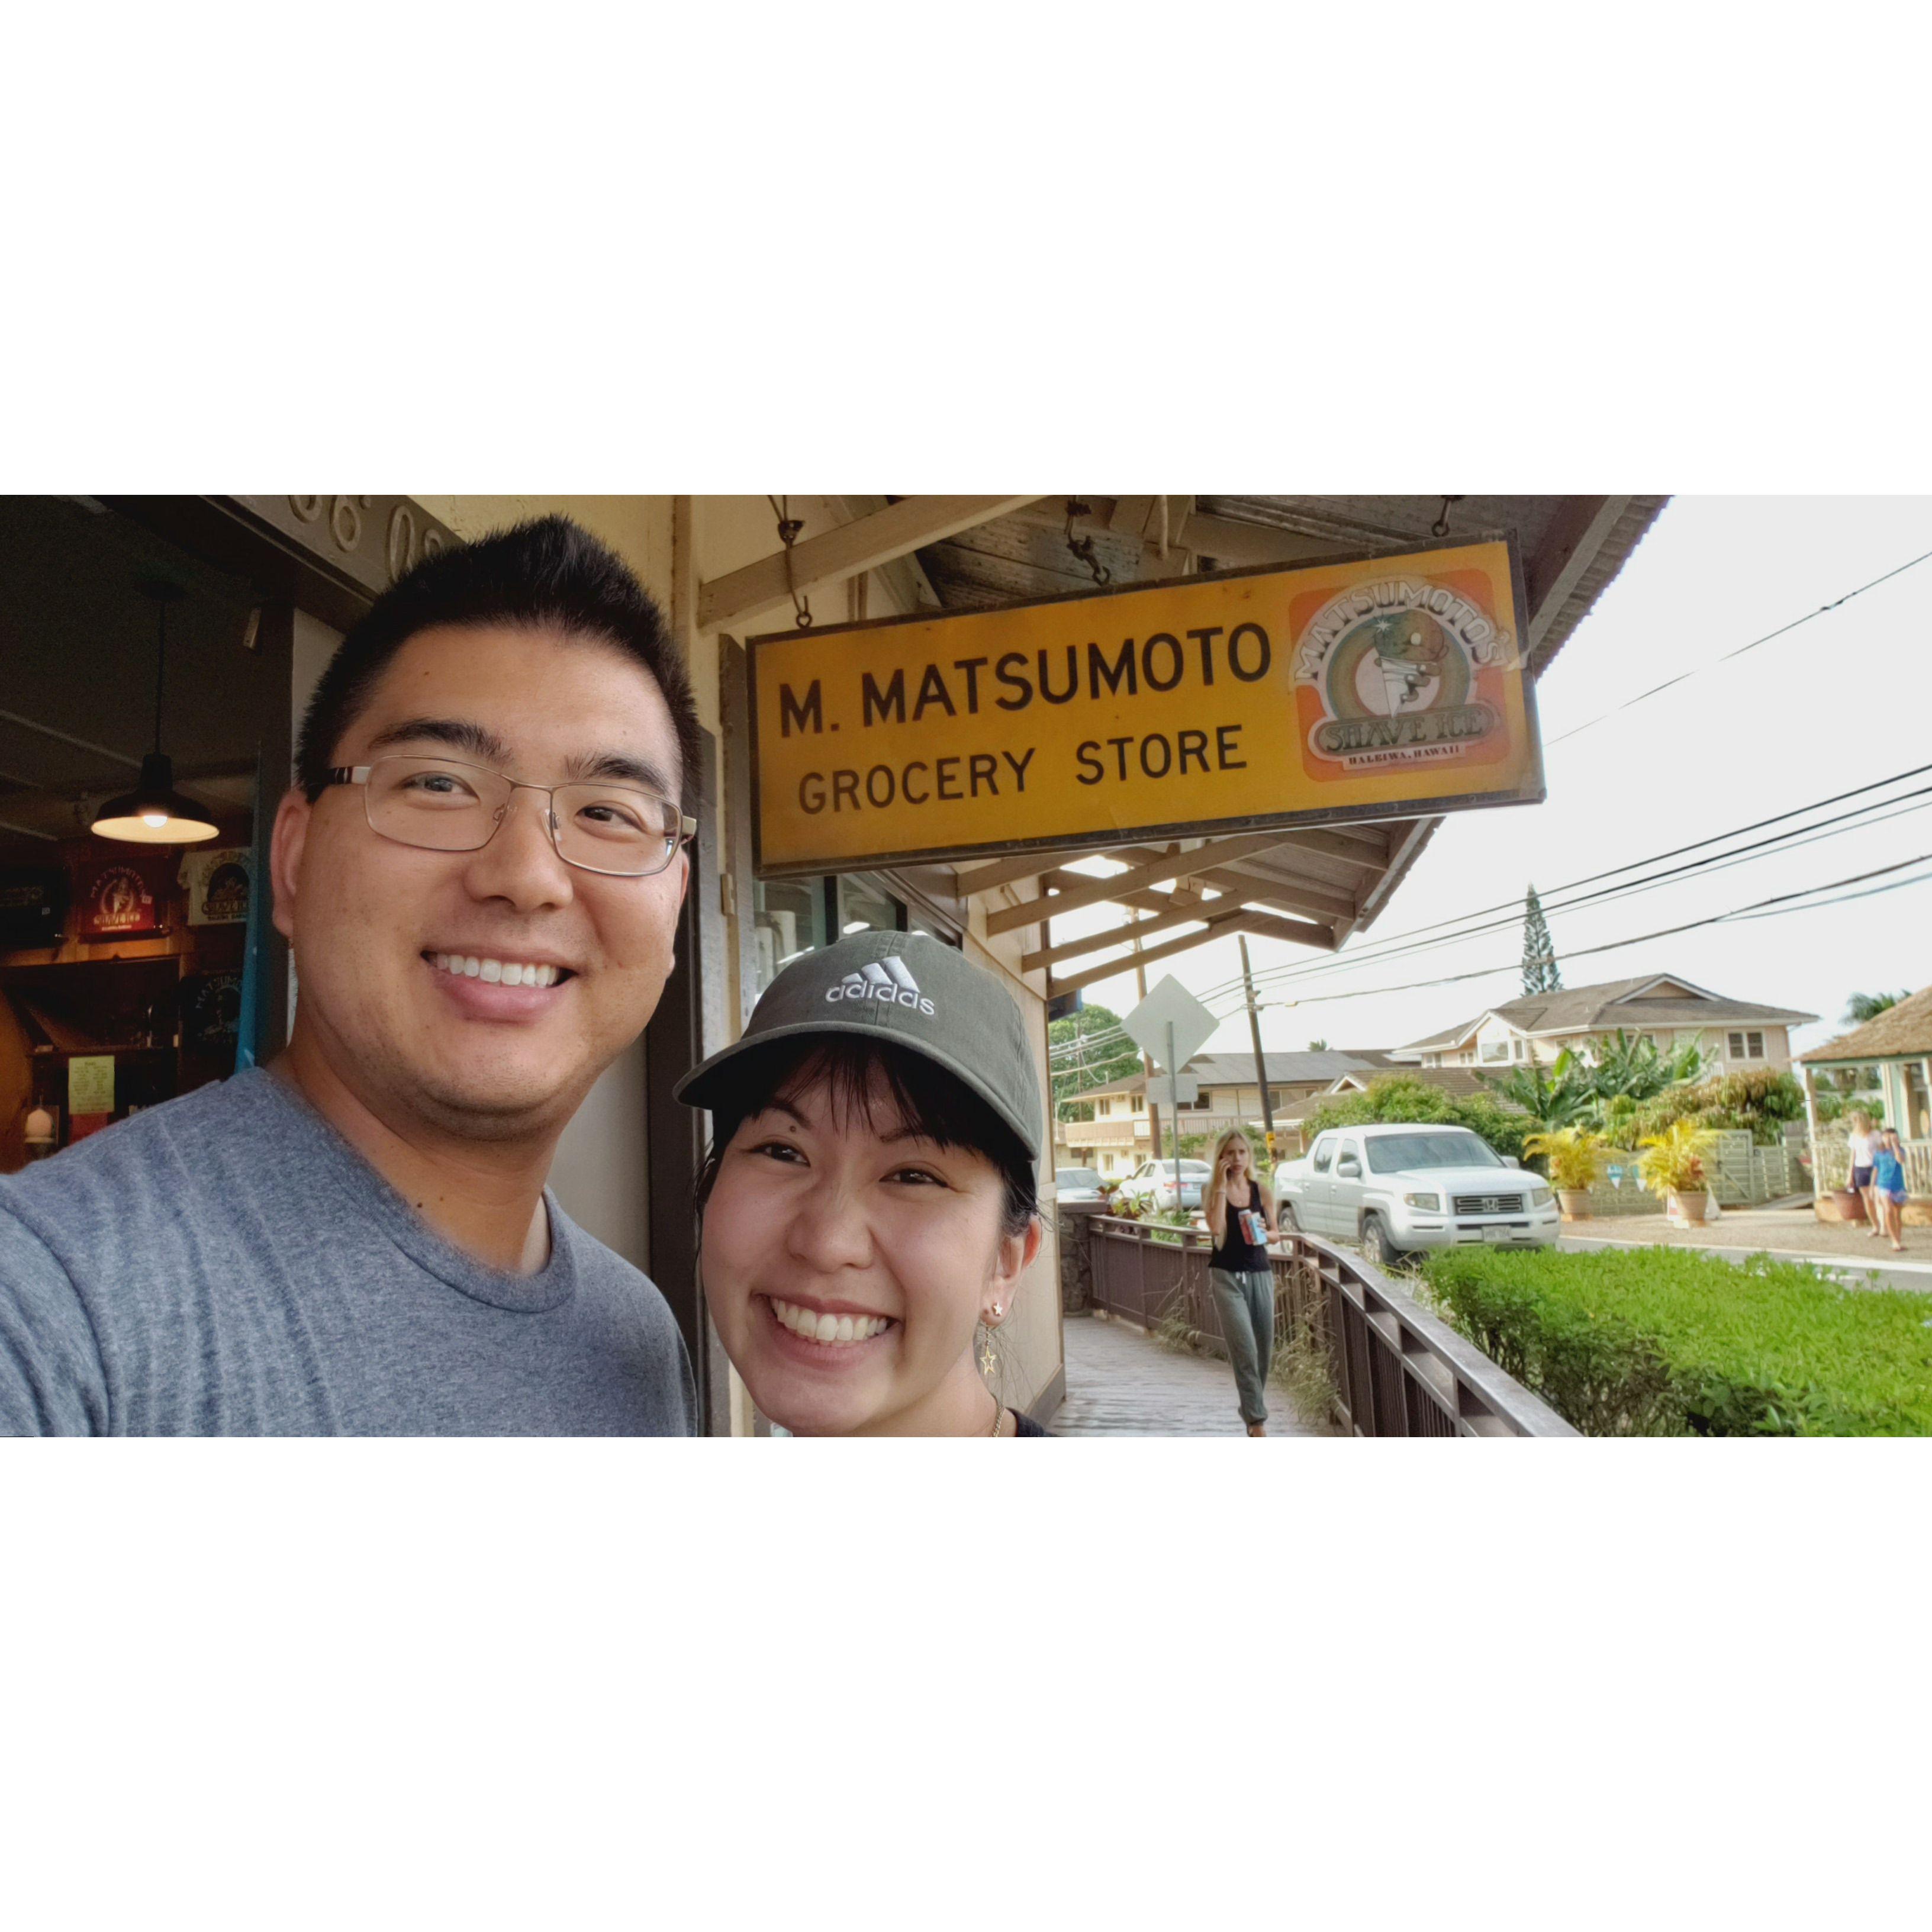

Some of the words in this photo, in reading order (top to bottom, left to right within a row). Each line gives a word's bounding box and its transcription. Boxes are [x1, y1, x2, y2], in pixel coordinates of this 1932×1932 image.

[780, 679, 840, 739] M.
[861, 622, 1271, 727] MATSUMOTO
[1326, 716, 1427, 751] SHAVE
[1436, 710, 1483, 740] ICE
[798, 747, 1036, 815] GROCERY
[1075, 724, 1248, 785] STORE
[1413, 745, 1460, 758] HAWAII
[825, 980, 935, 1016] adidas
